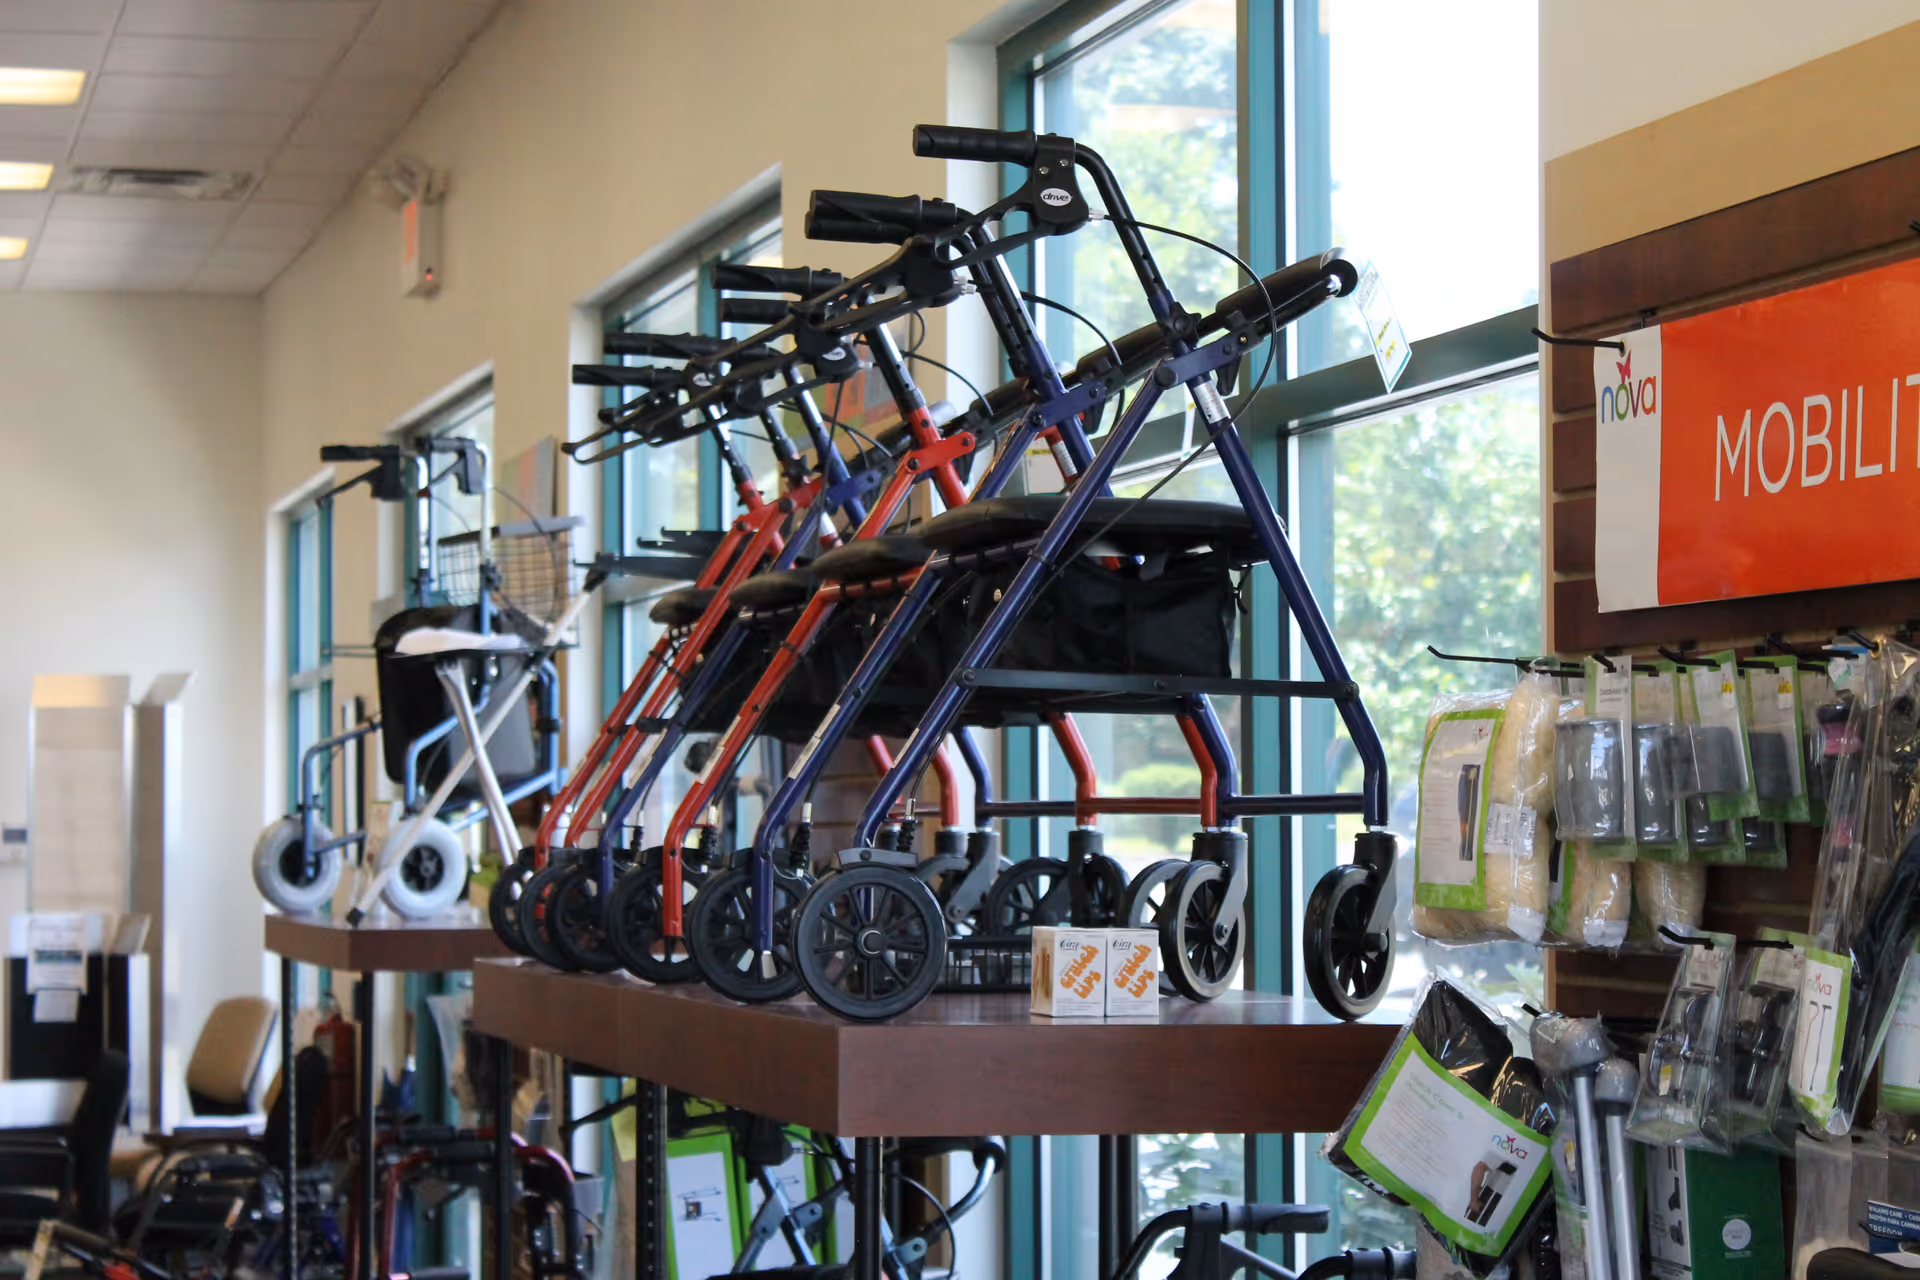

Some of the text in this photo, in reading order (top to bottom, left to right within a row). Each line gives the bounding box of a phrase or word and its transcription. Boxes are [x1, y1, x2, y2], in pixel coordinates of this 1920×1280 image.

[1043, 192, 1068, 202] drive
[1601, 375, 1657, 424] nova
[1491, 1134, 1528, 1160] nova
